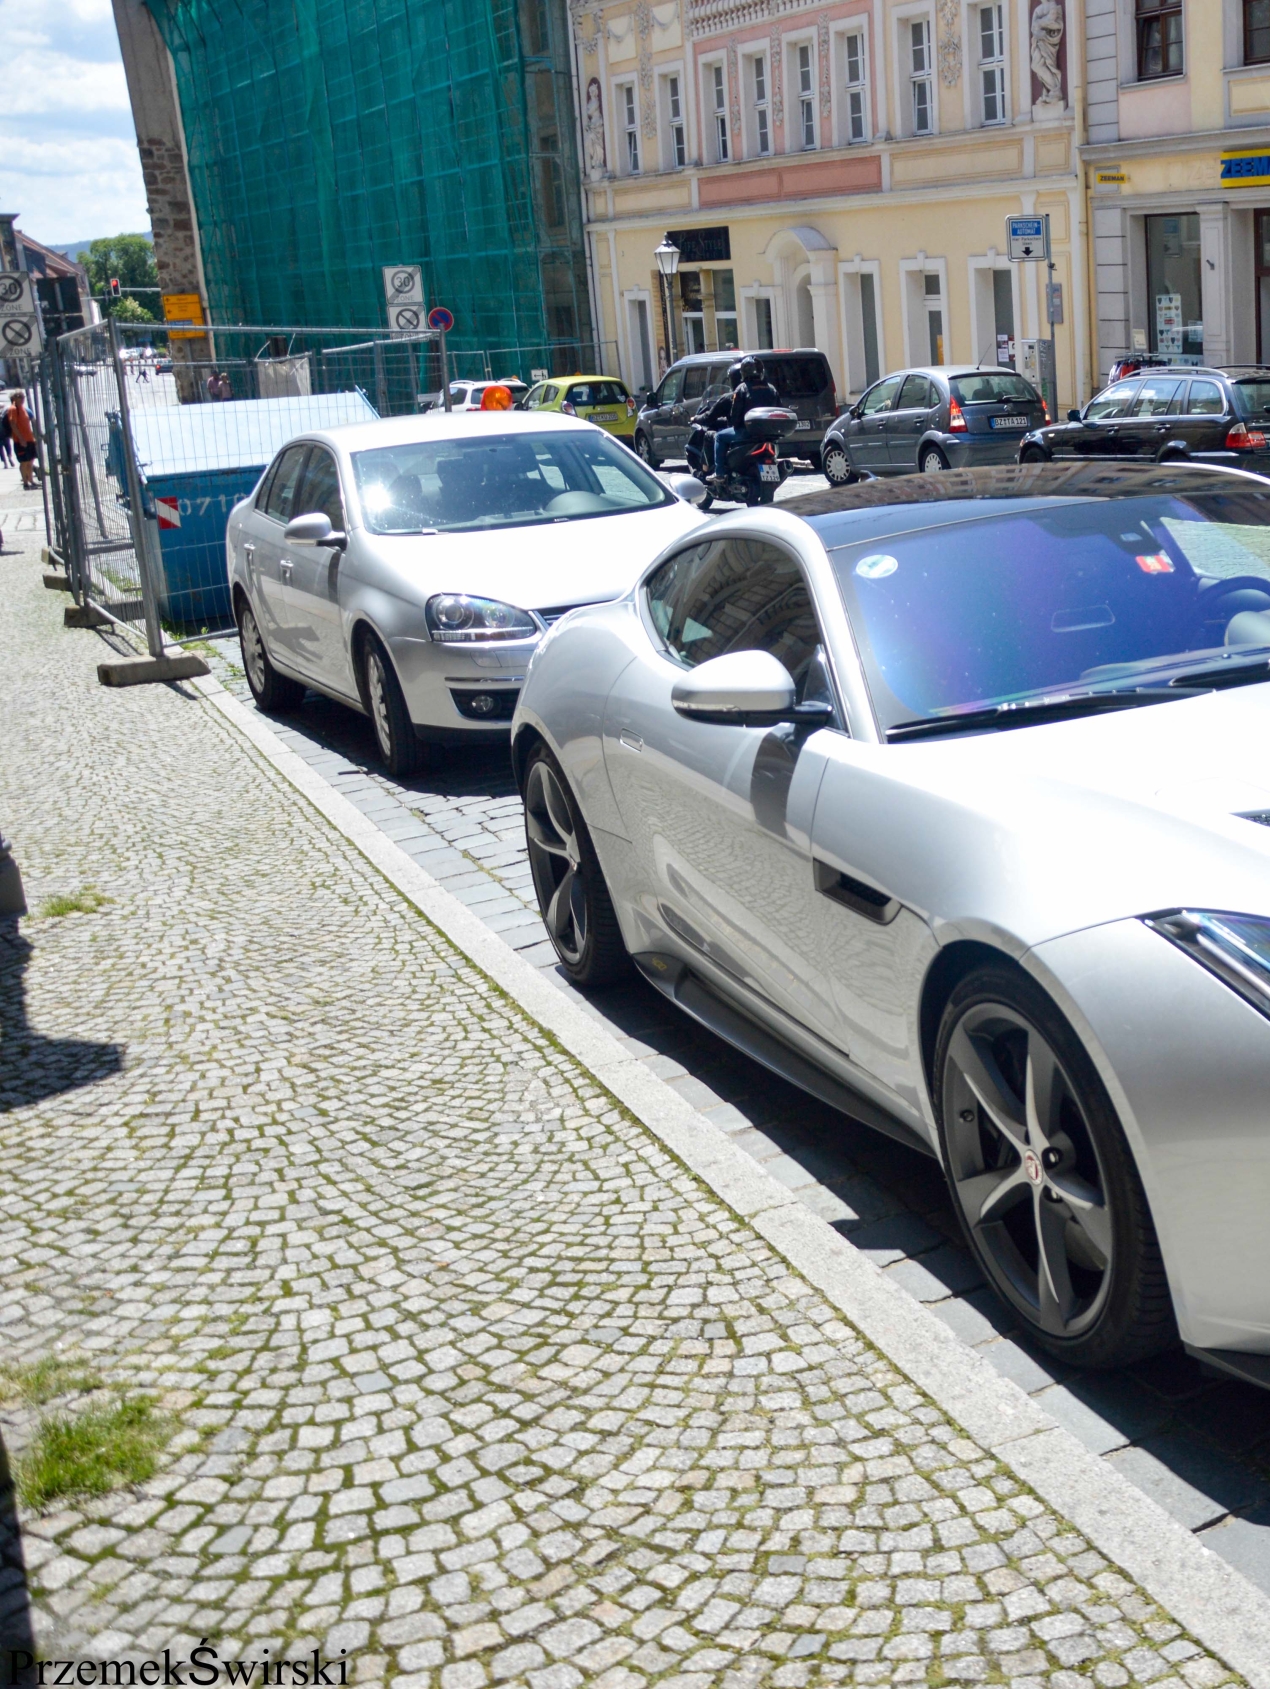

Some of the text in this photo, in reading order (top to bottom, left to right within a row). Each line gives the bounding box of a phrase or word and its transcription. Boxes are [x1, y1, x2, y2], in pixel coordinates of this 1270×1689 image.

[396, 276, 411, 288] 30
[1, 303, 24, 311] ZONE
[10, 347, 32, 356] ZONE
[995, 418, 1004, 426] BZ
[1016, 417, 1027, 425] 121
